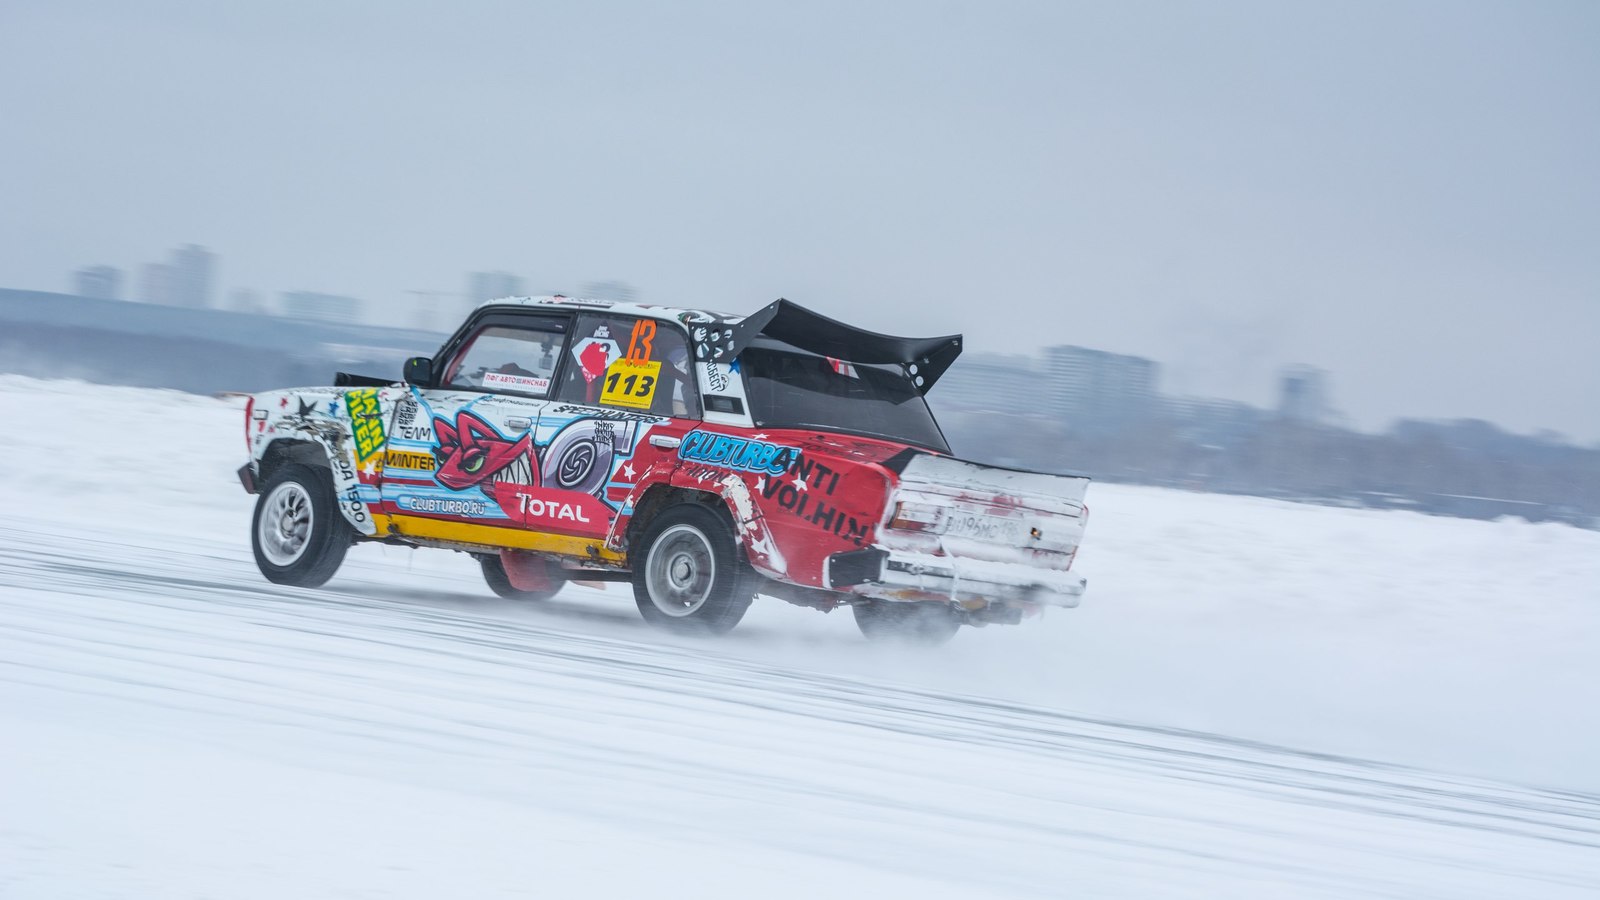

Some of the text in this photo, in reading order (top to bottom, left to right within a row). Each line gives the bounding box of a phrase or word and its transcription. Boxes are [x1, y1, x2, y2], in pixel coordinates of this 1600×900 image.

[625, 319, 657, 367] 13
[606, 372, 655, 397] 113
[706, 361, 722, 391] СБЕСТ
[399, 426, 431, 441] TEAM
[385, 451, 436, 471] WINTER
[772, 447, 841, 496] ANTI
[516, 492, 590, 523] TOTAL
[763, 473, 870, 546] VOLHIN
